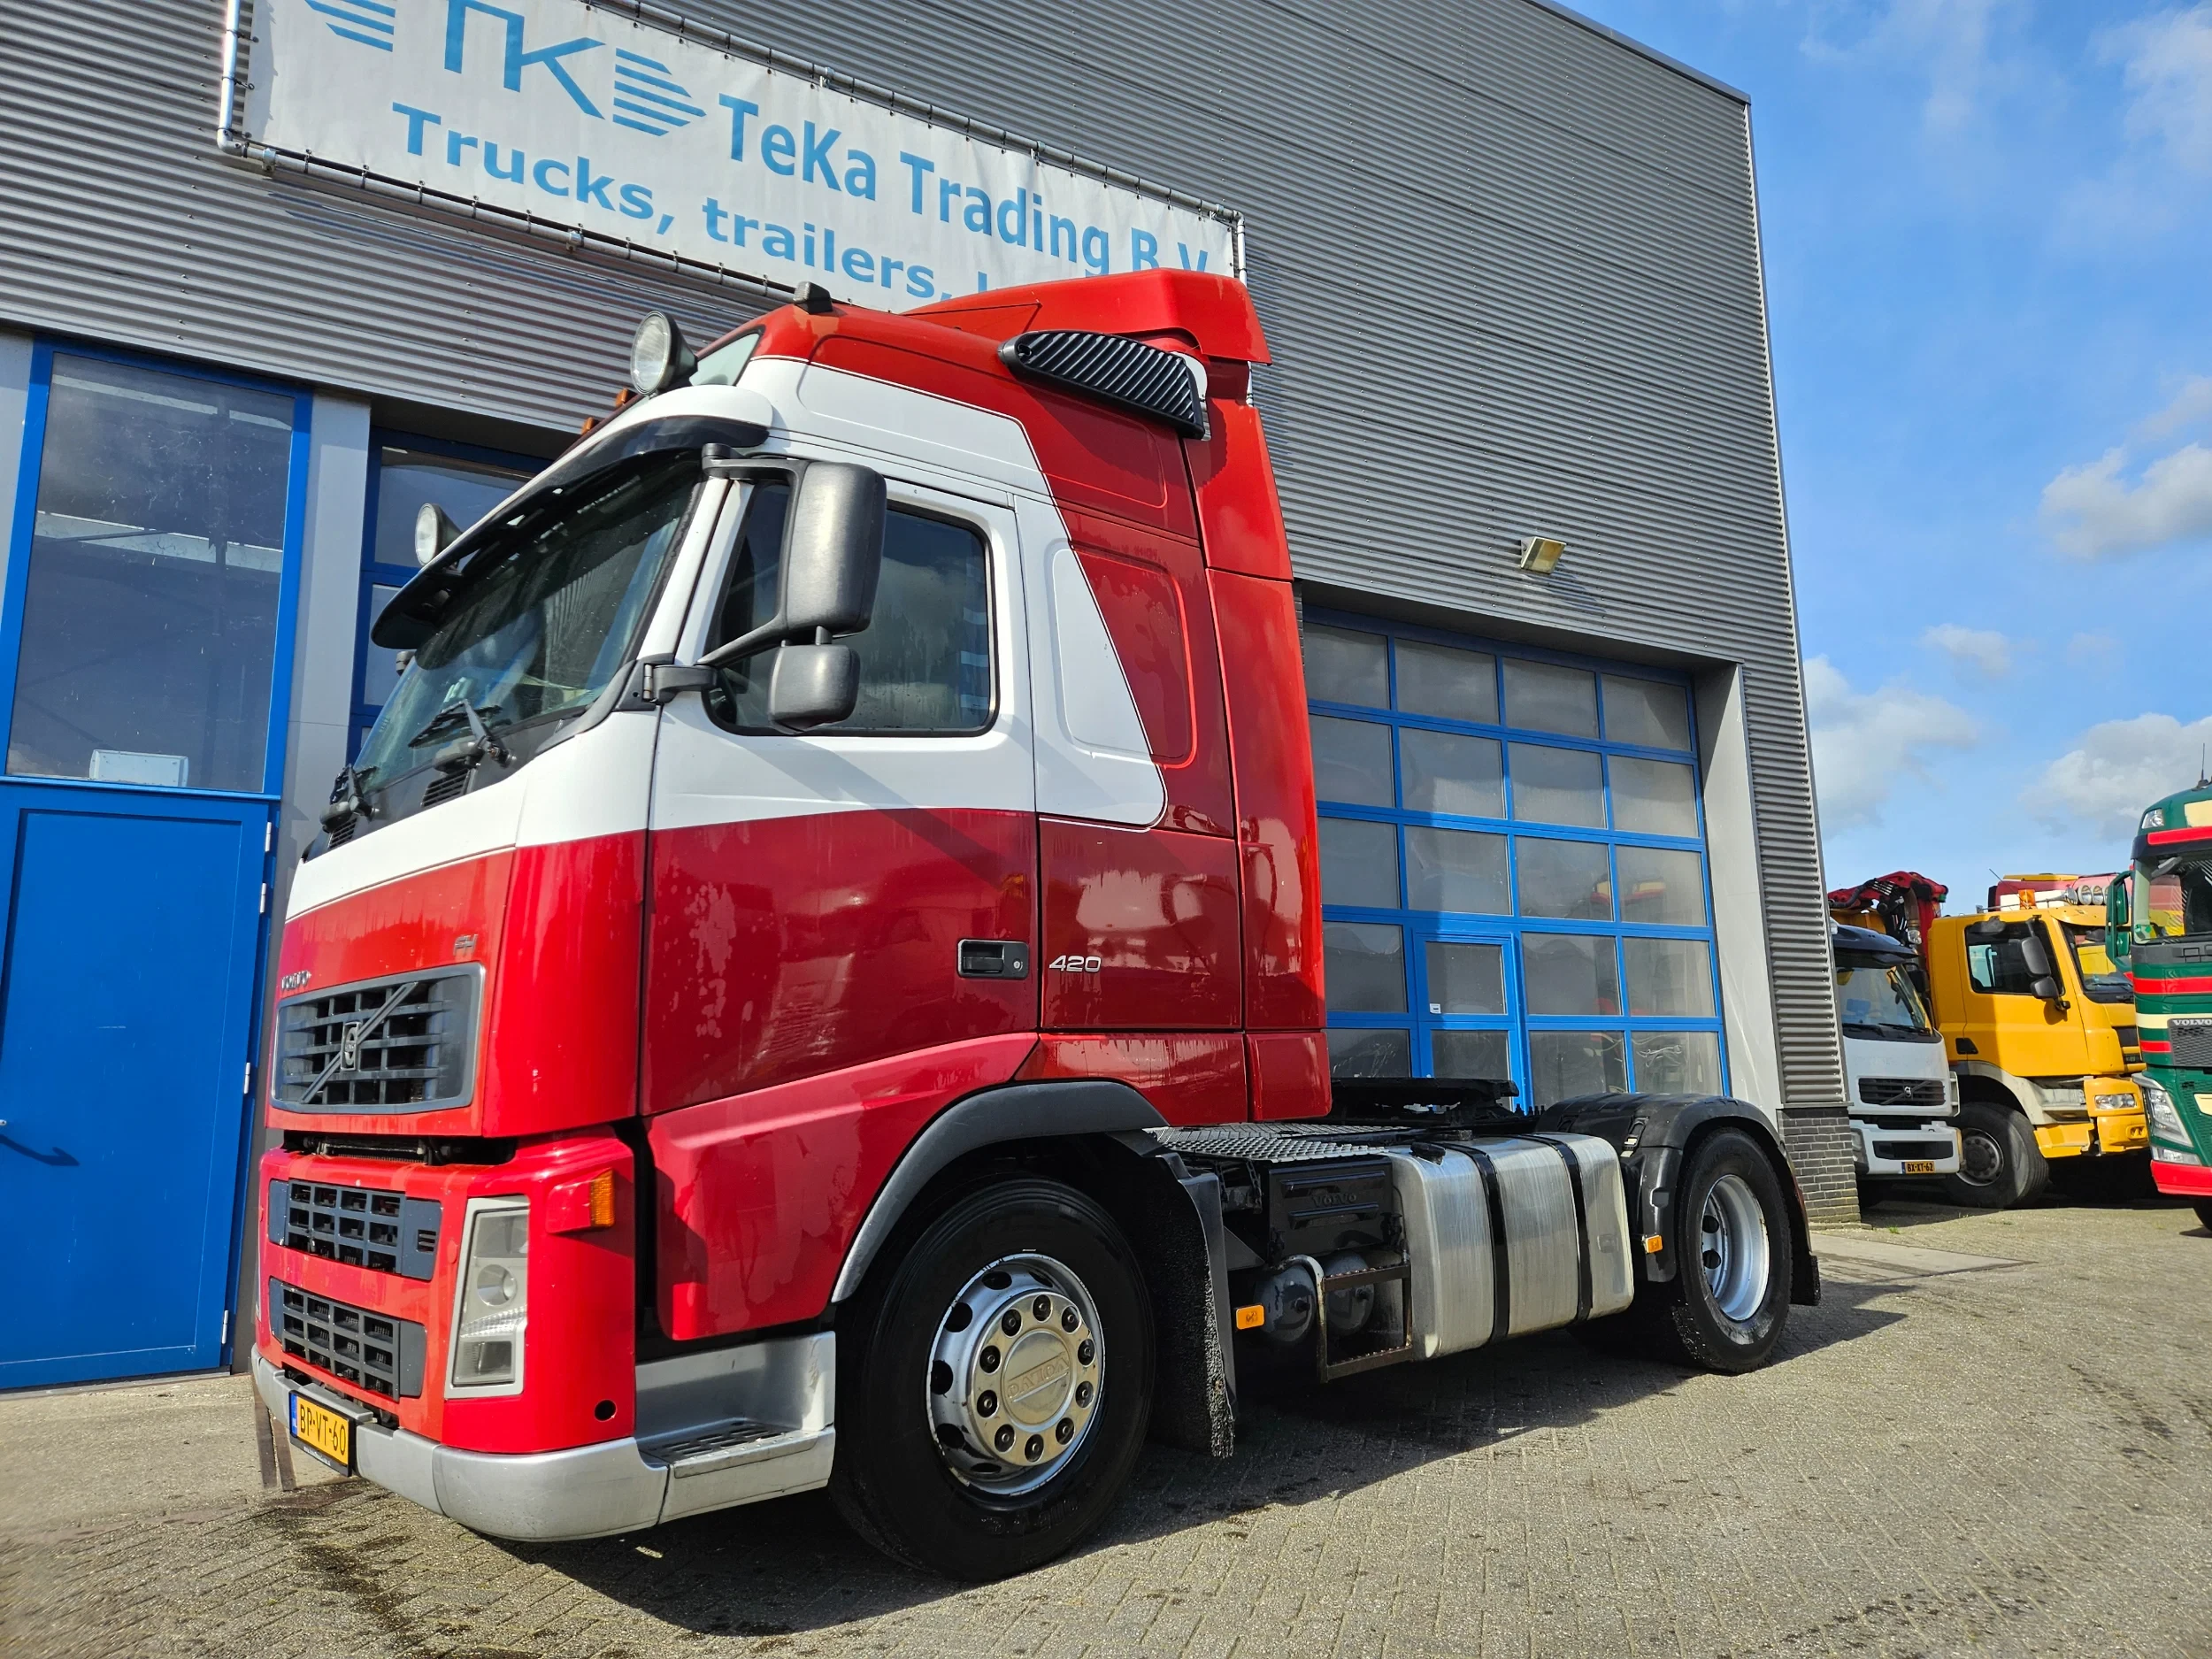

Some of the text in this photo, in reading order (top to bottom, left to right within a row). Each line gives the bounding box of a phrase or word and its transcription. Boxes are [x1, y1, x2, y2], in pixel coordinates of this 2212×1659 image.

[392, 102, 675, 235] Trucks,
[718, 93, 877, 202] TeKa
[899, 150, 1110, 277] Trading
[1048, 955, 1102, 973] 420
